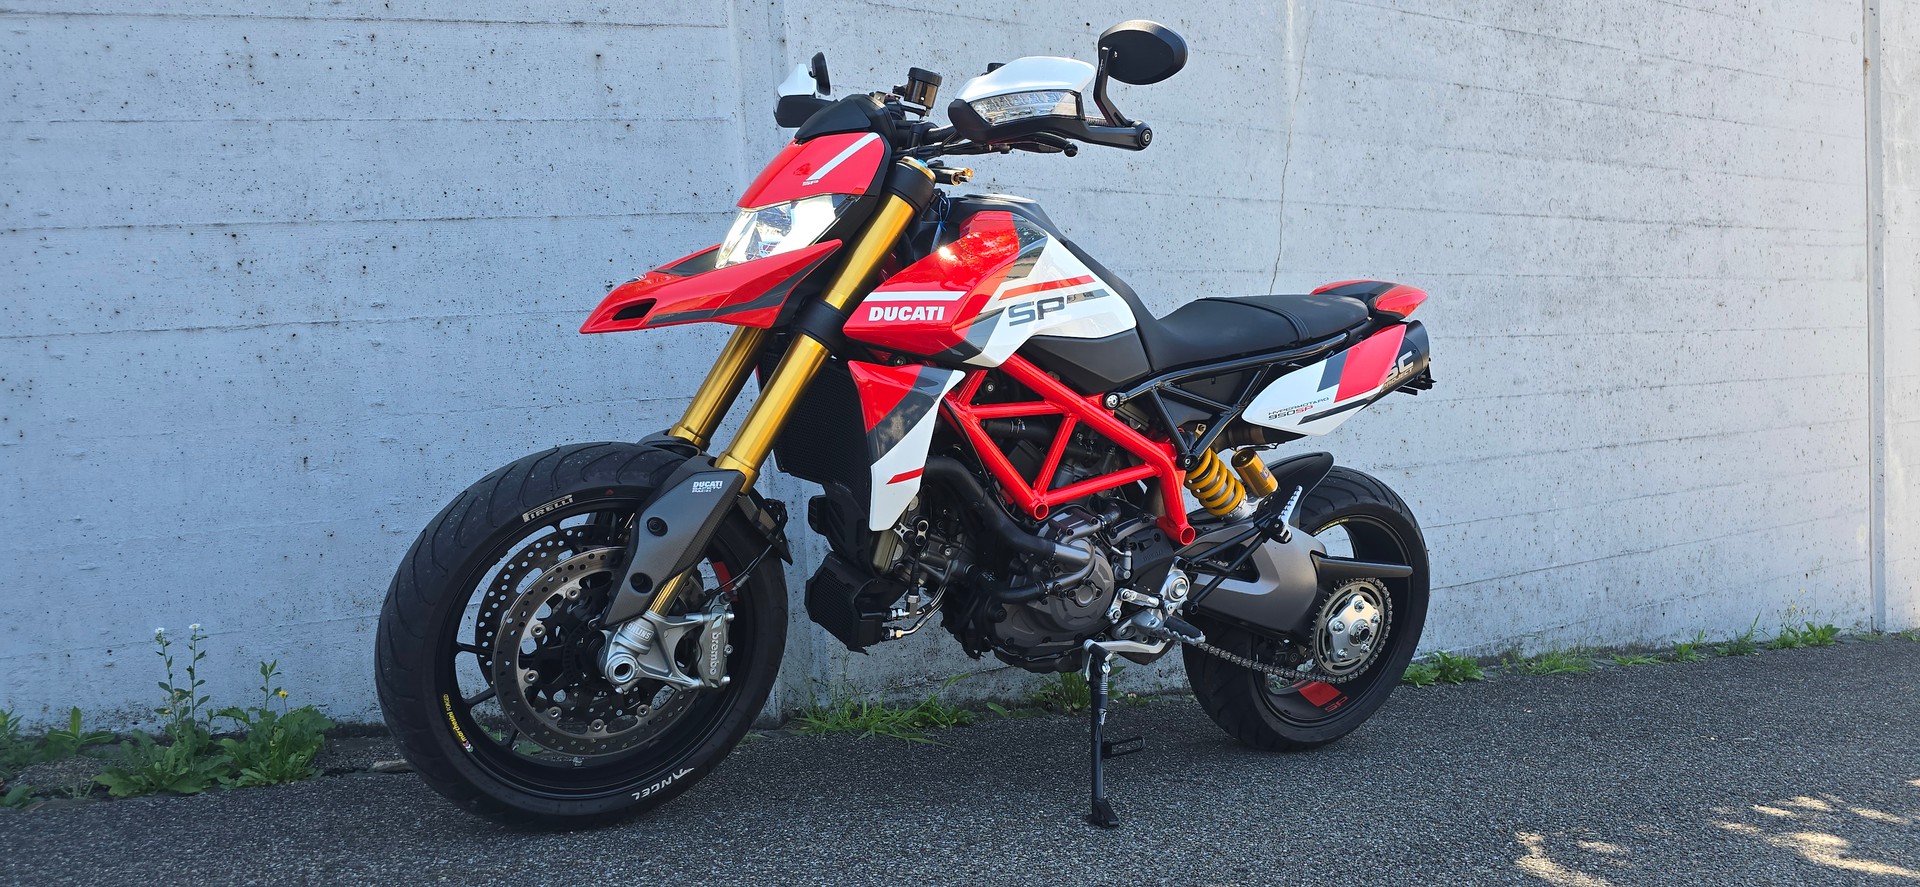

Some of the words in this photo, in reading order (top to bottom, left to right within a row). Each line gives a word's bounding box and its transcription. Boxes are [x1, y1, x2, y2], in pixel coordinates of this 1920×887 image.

[868, 306, 945, 322] DUCATI
[1008, 296, 1065, 327] SP
[1268, 397, 1329, 415] HYPERMOTARD
[1268, 405, 1314, 420] 950SP
[693, 480, 723, 488] DUCATI
[522, 494, 574, 523] PIRELLI
[709, 632, 722, 676] brembo
[1325, 696, 1349, 712] SP
[447, 711, 467, 742] marchesini
[631, 767, 695, 801] ANGEL
